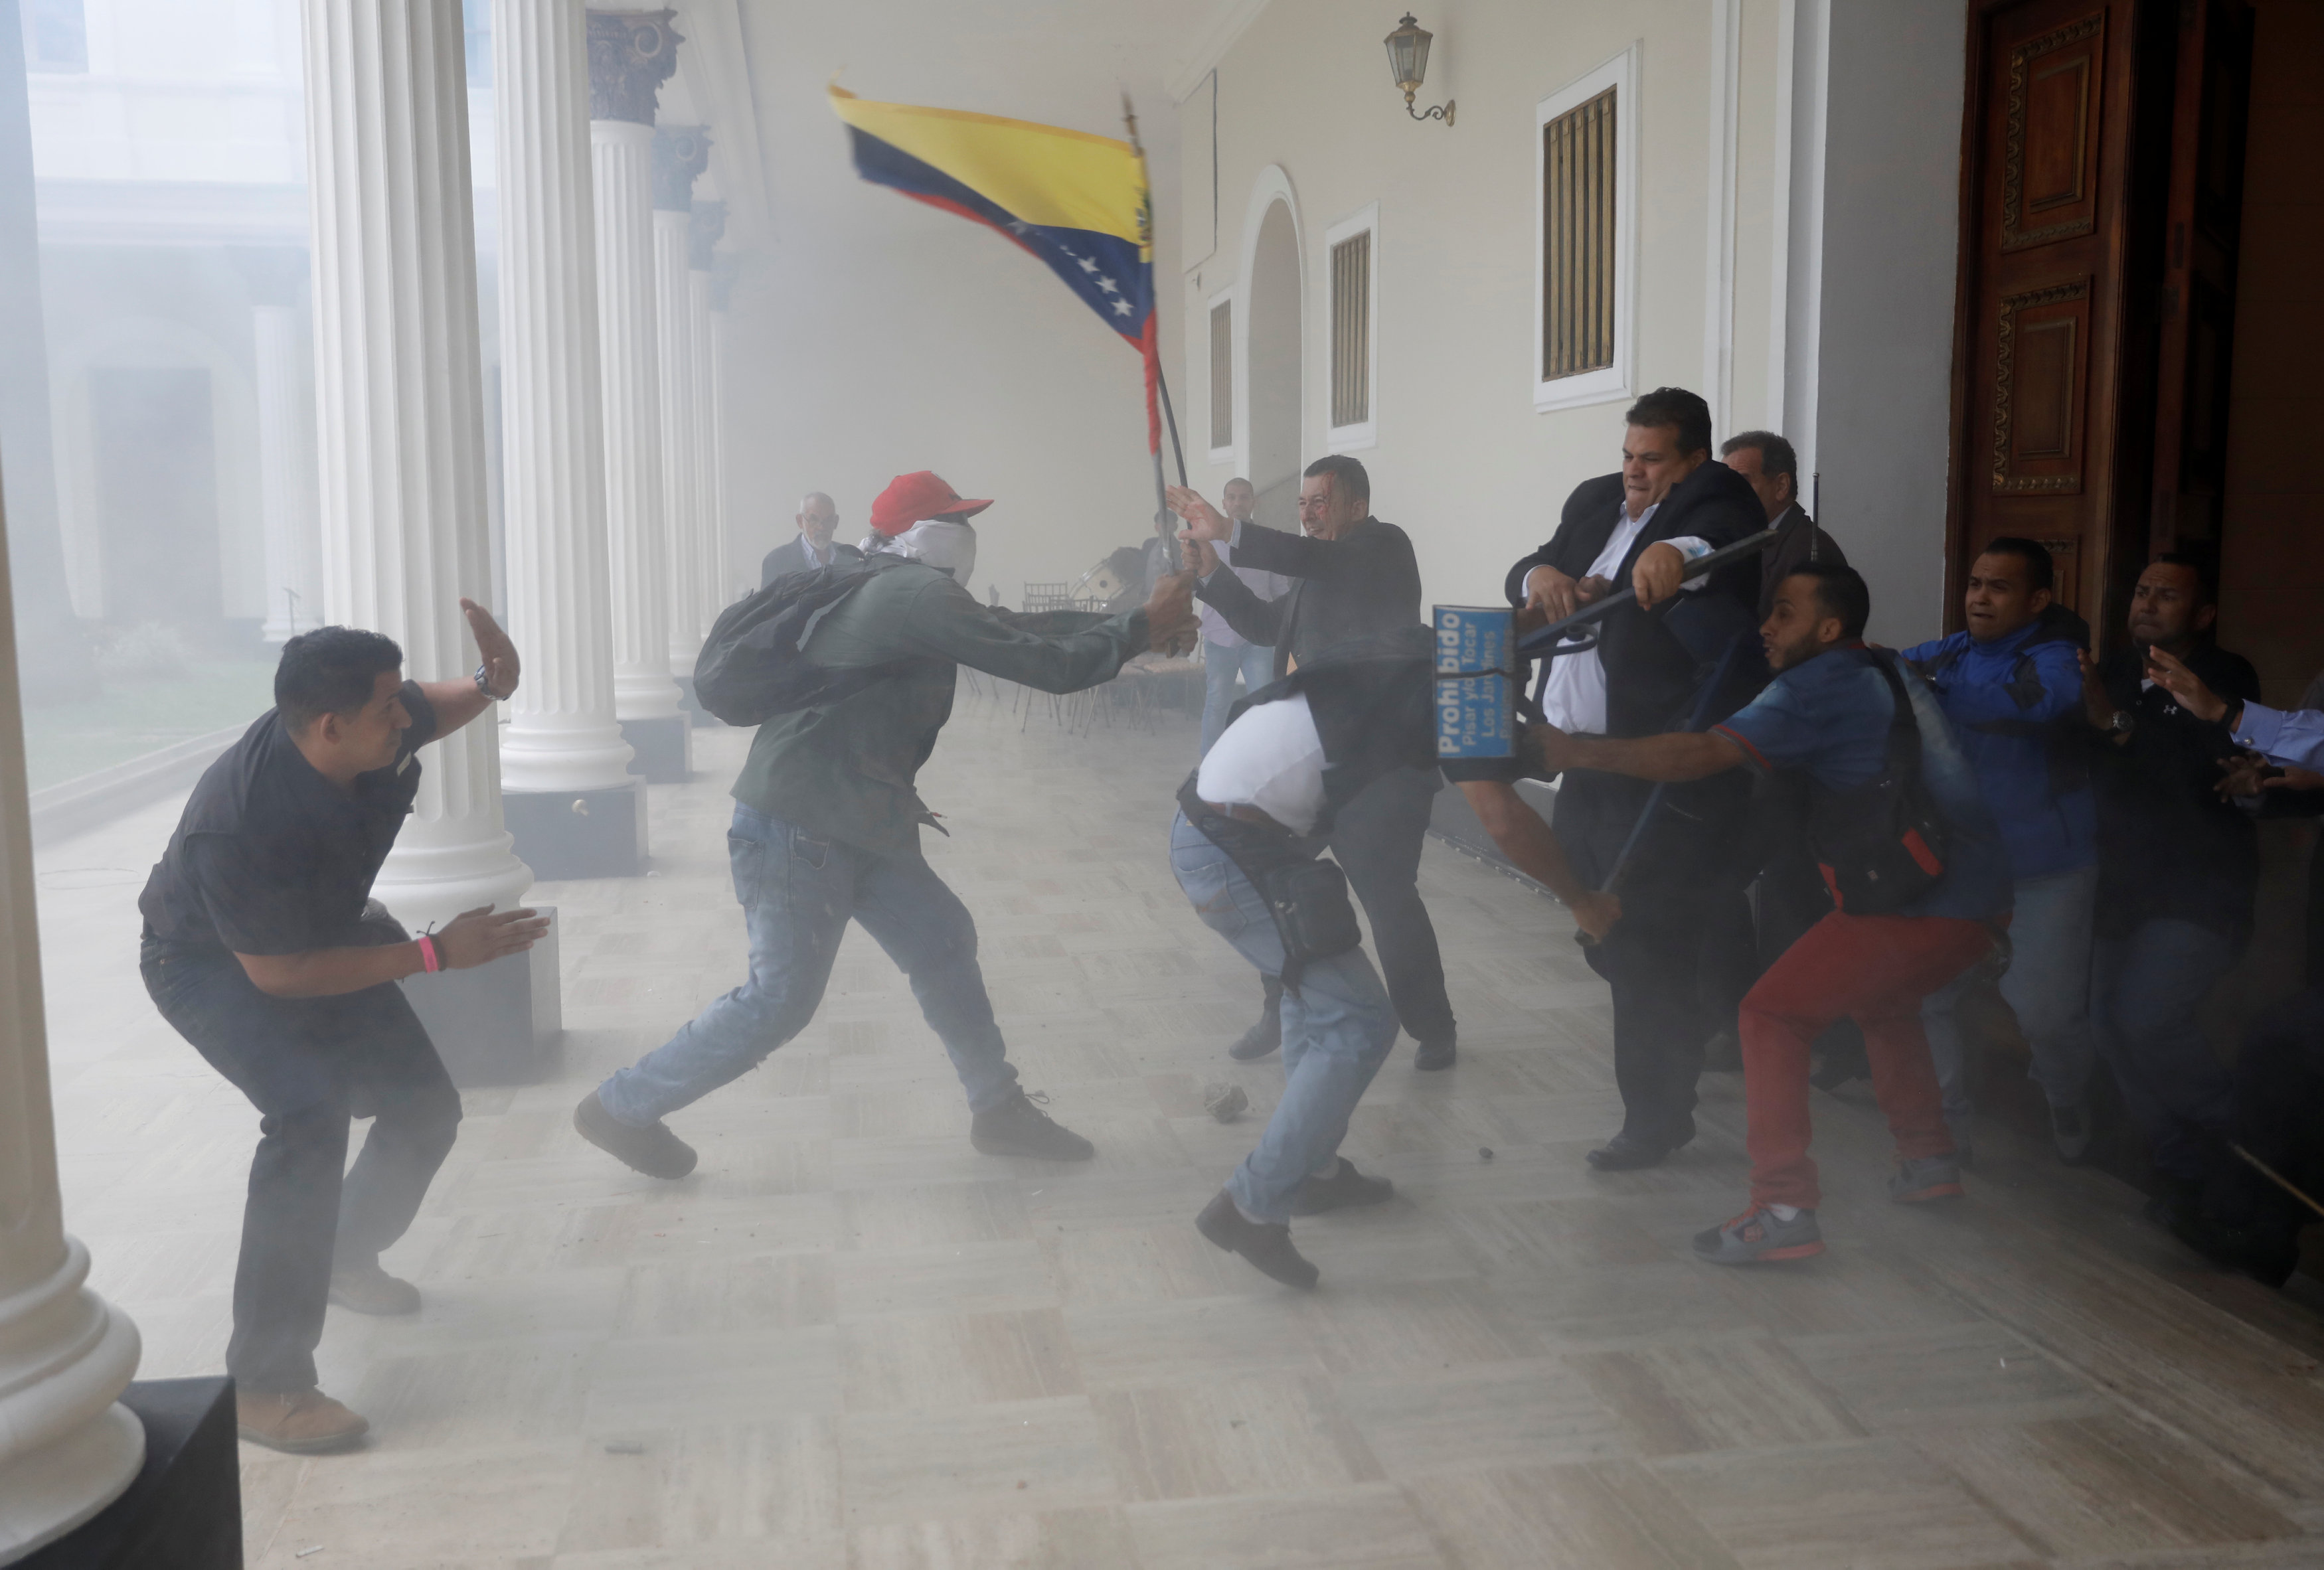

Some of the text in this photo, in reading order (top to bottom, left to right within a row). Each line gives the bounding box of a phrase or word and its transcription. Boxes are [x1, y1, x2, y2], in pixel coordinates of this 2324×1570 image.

[1437, 613, 1460, 753] Prohibido
[1461, 623, 1478, 745] Pisar y/o Tocar
[1481, 631, 1495, 737] Los Jardines
